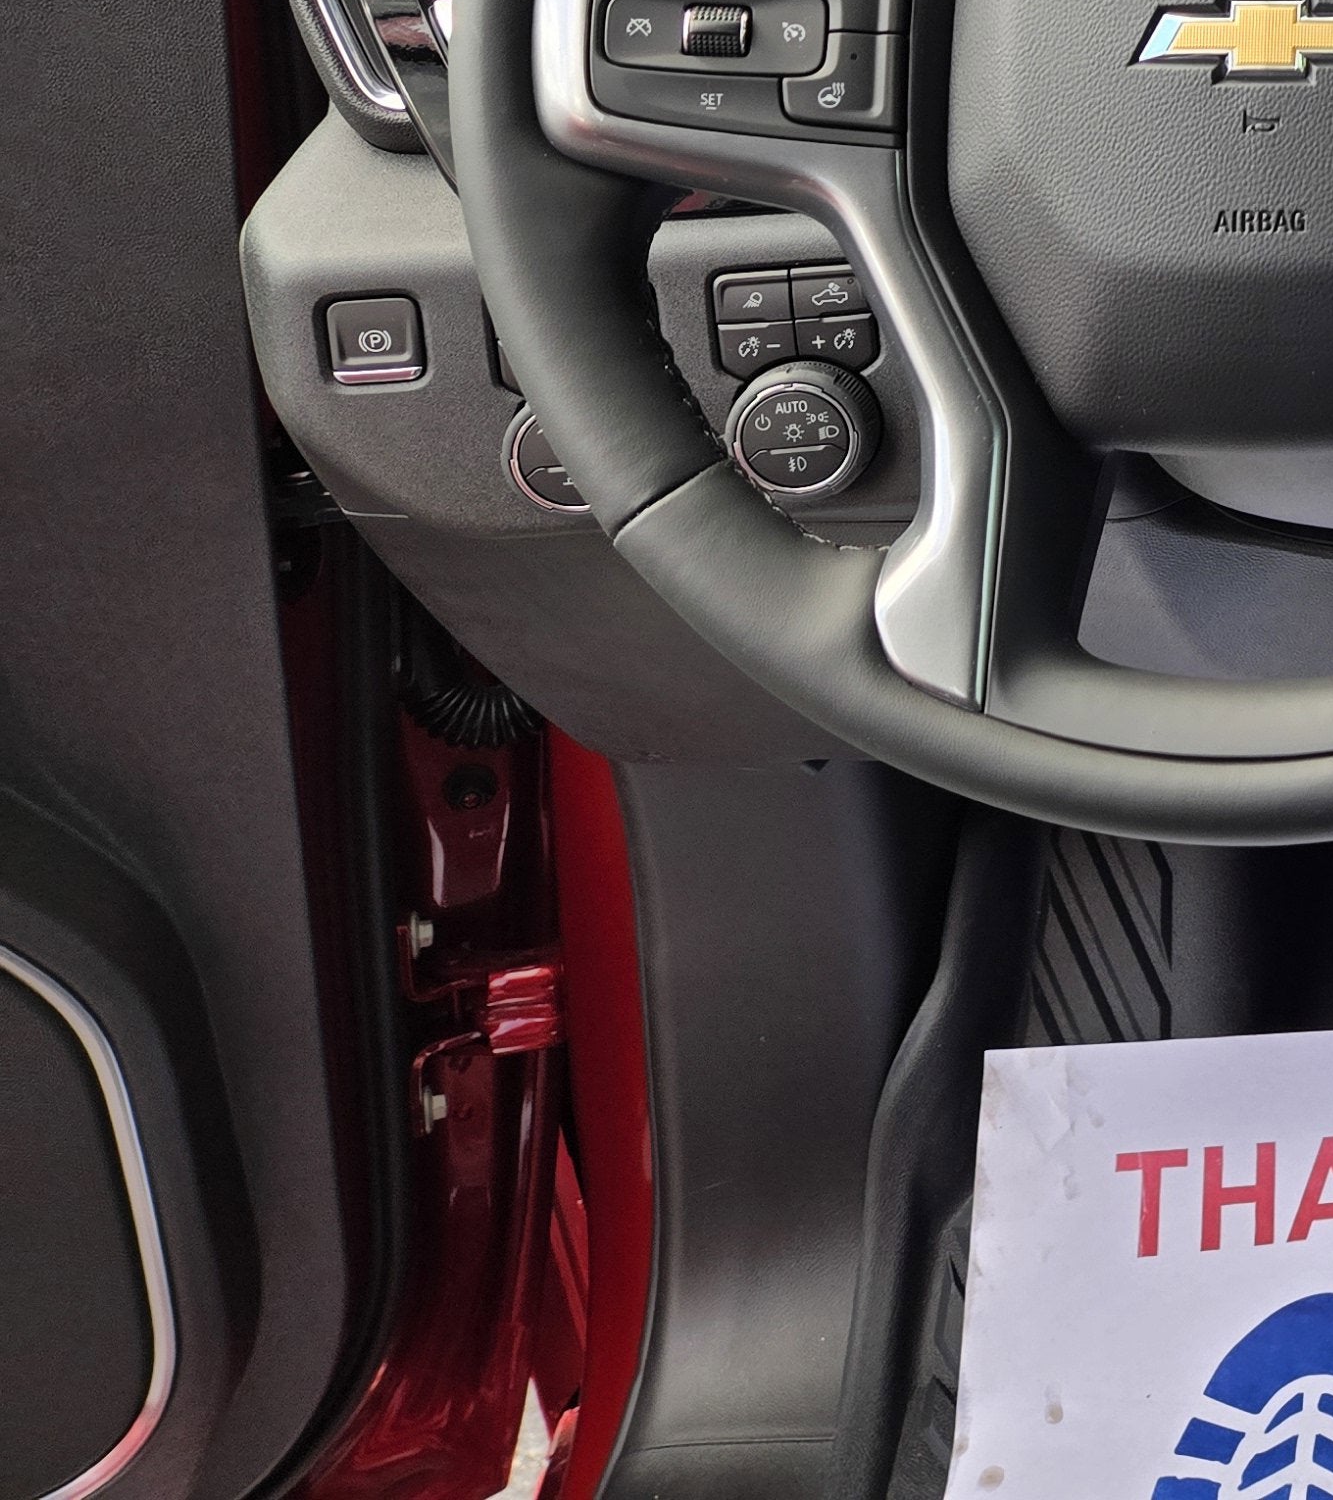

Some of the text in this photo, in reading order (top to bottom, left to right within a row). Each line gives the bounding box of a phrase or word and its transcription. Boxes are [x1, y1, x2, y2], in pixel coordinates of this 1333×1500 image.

[700, 93, 723, 105] SET
[1214, 210, 1306, 233] AIRBAG
[775, 401, 807, 415] AUTO
